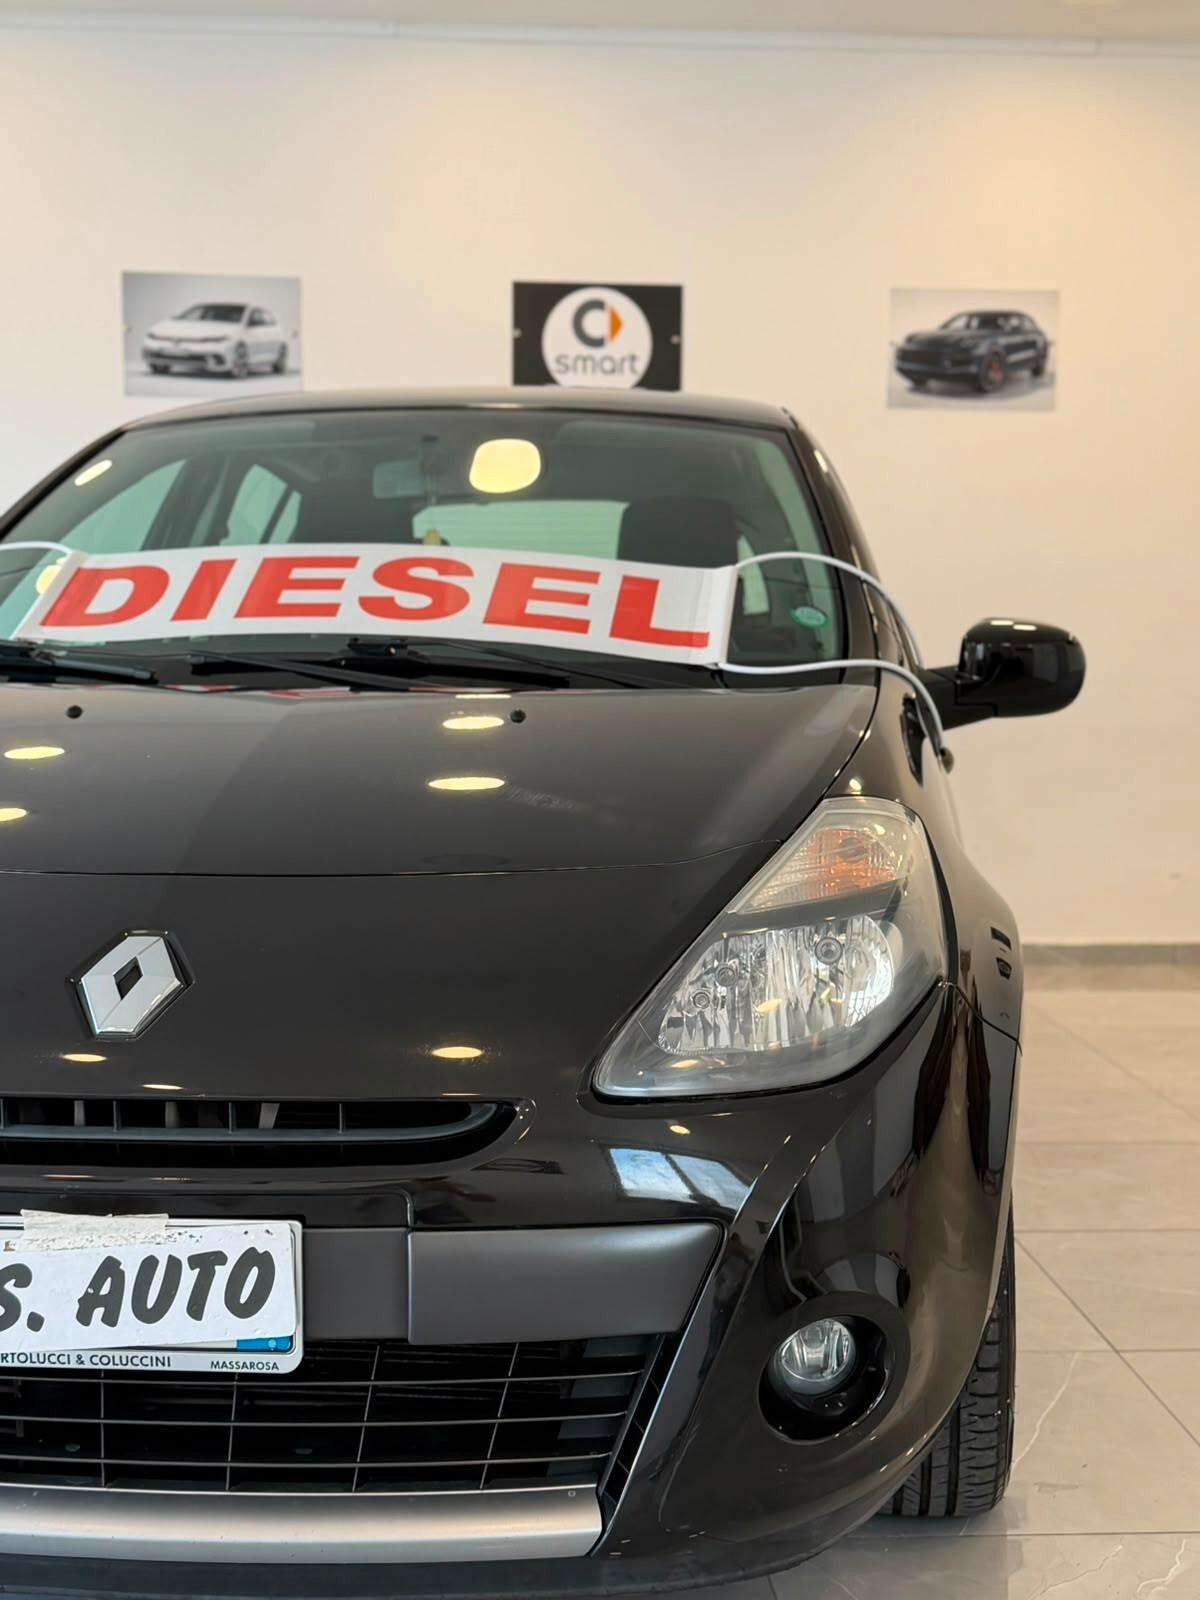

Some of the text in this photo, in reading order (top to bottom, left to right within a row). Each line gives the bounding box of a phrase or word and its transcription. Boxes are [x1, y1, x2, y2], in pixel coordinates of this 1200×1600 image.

[555, 353, 639, 375] smart
[40, 555, 710, 649] DIESEL
[75, 1246, 276, 1329] AUTO
[75, 1353, 86, 1366] &
[89, 1354, 172, 1367] COLUCCINI
[210, 1360, 280, 1371] MASSAROSA
